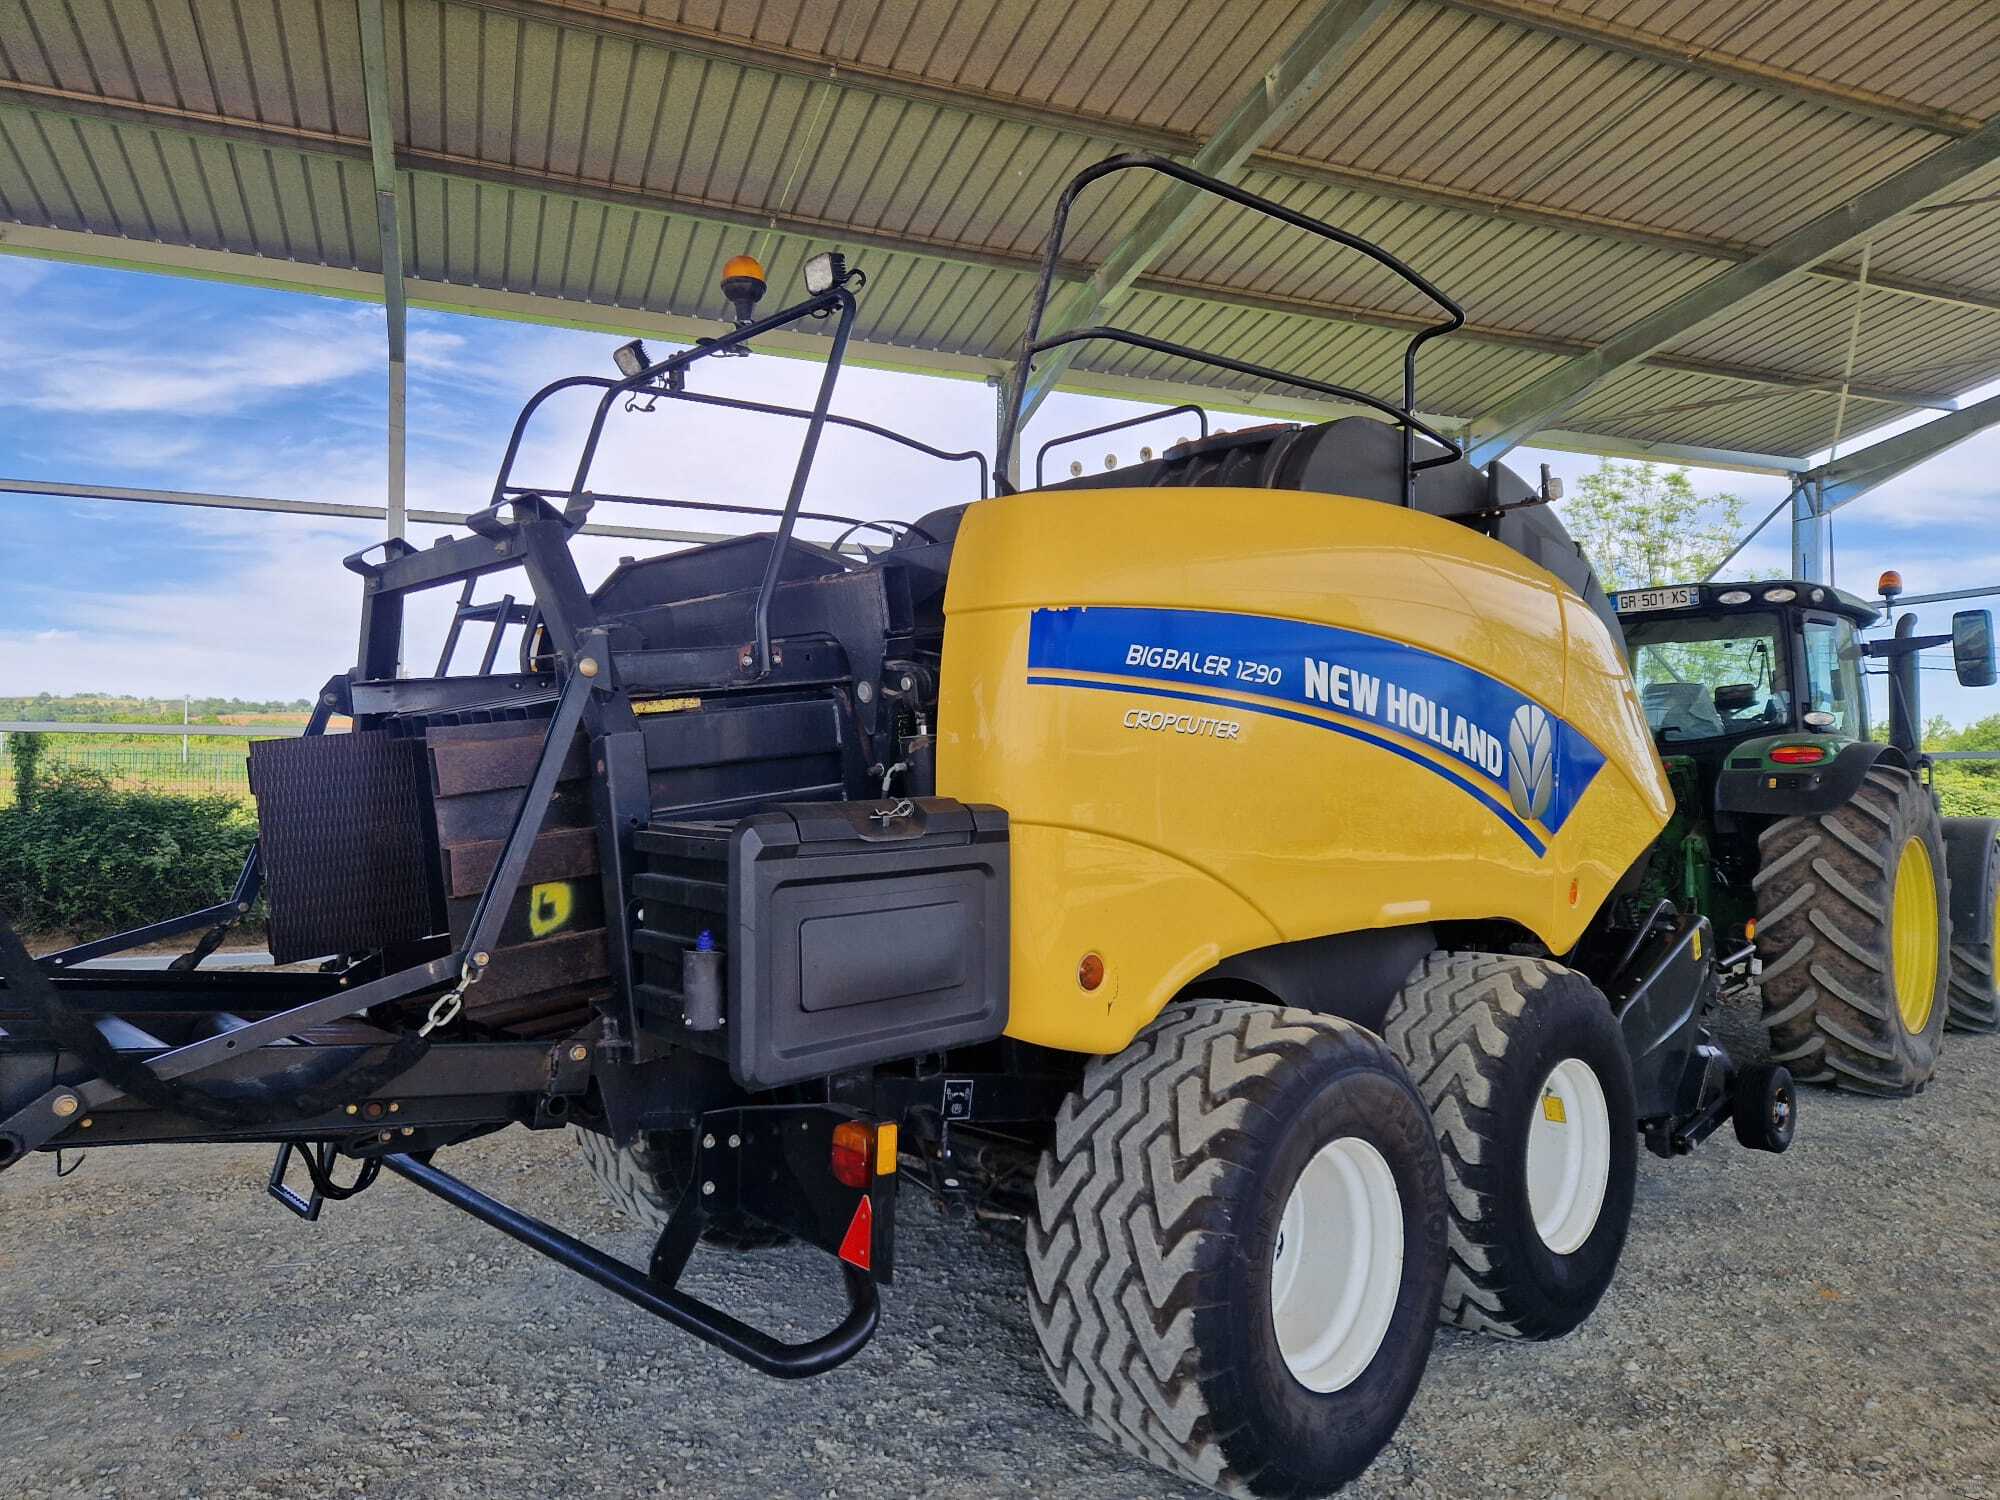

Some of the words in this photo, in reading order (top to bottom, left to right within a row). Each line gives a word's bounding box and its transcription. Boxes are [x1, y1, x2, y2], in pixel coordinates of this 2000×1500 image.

[1126, 643, 1231, 678] BIGBALER
[1236, 659, 1282, 686] 1290
[1123, 708, 1241, 739] CROPCUTTER
[1304, 656, 1380, 717] NEW
[1387, 682, 1503, 778] HOLLAND
